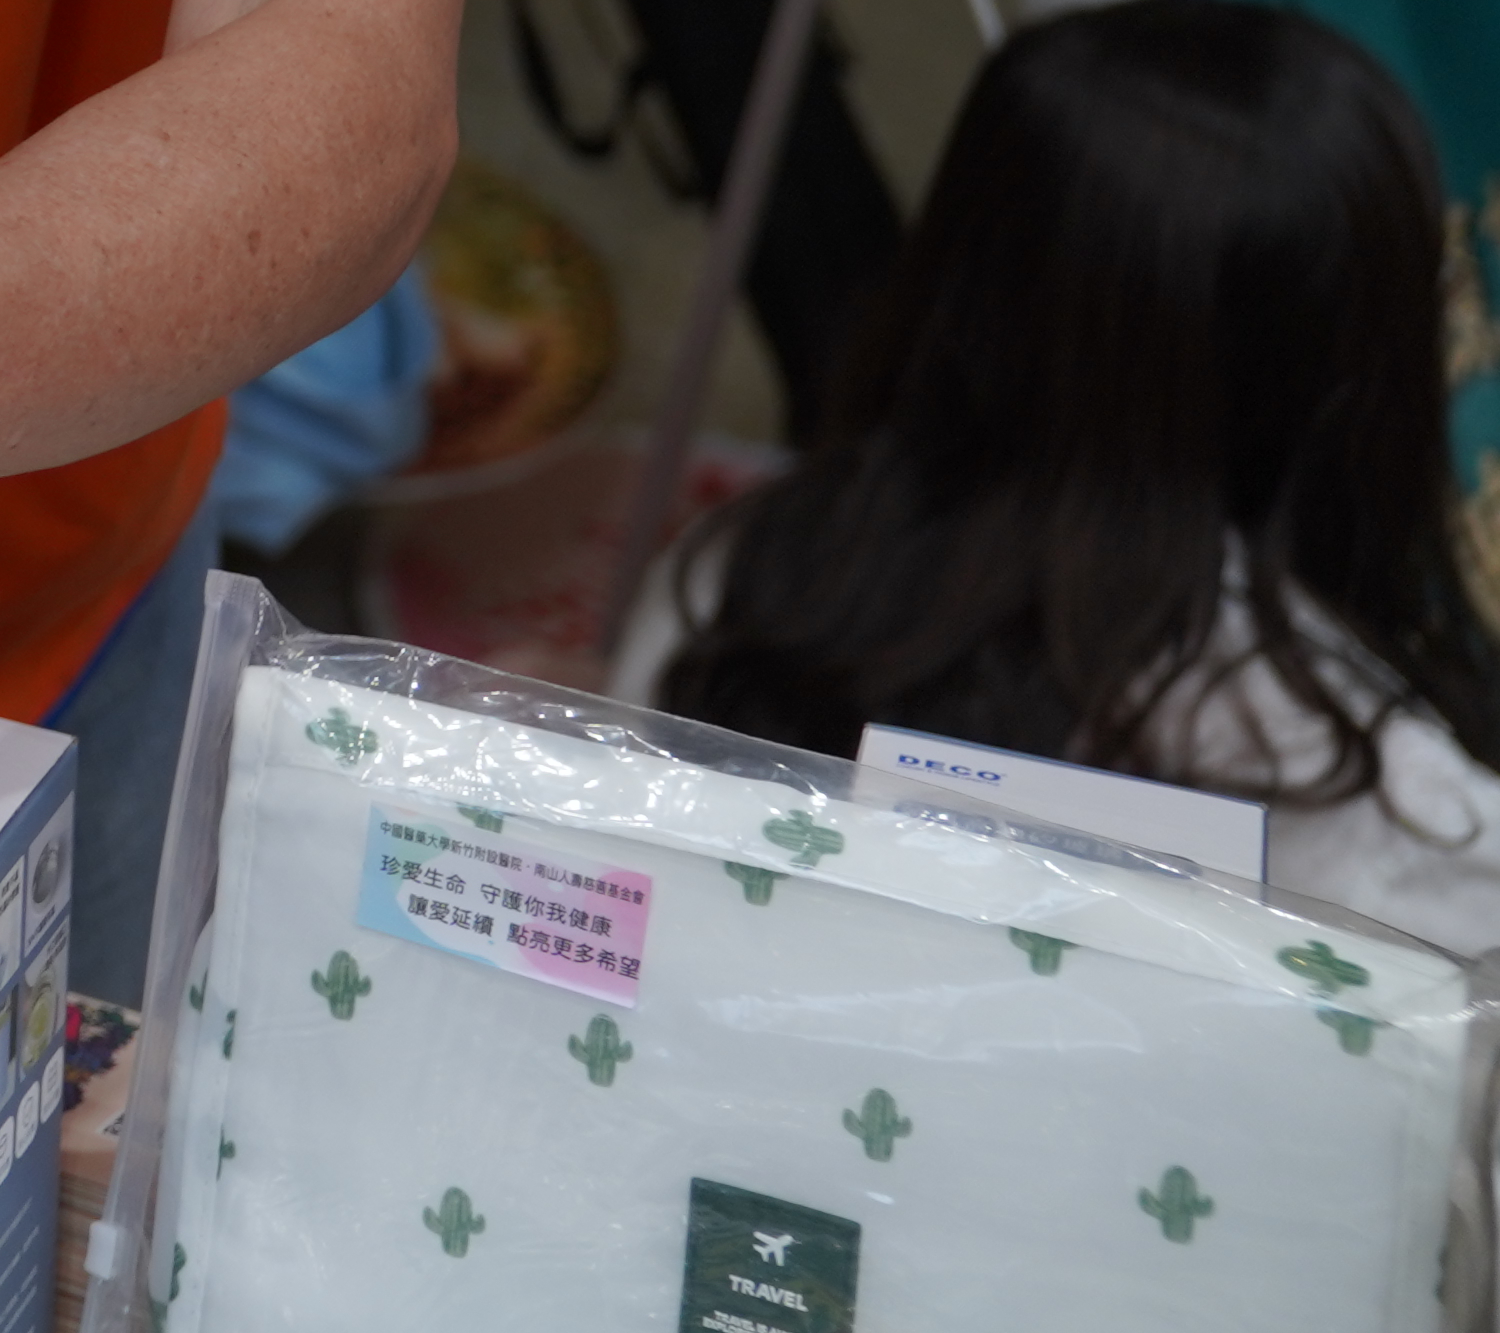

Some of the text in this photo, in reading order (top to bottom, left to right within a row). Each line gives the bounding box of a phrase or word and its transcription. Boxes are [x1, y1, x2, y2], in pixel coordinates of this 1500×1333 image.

[898, 753, 1001, 783] DECO
[380, 854, 613, 938] 珍愛生命 守護你我健康
[407, 893, 641, 981] 讓愛延續 點亮更多希望
[728, 1273, 809, 1312] TRAVEL
